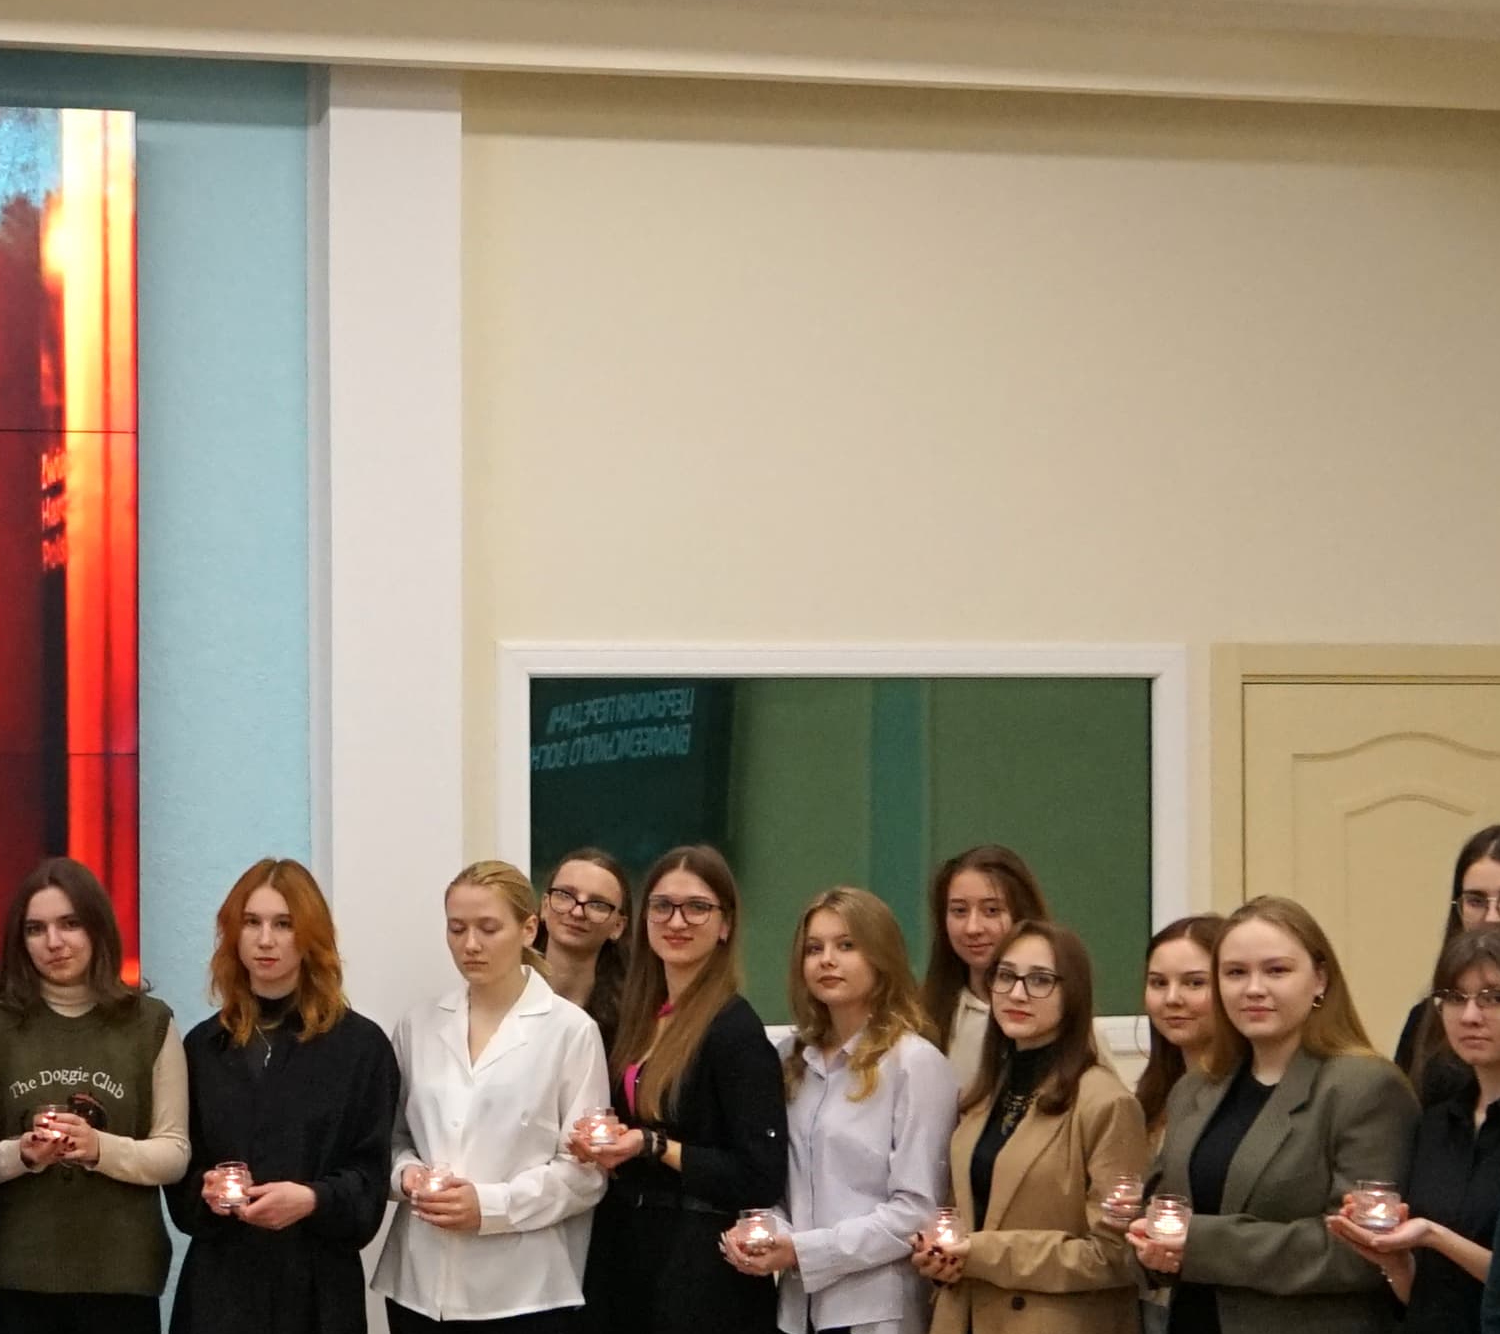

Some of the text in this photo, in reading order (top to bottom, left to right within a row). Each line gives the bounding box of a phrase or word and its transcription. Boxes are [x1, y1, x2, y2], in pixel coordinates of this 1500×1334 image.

[9, 1066, 125, 1100] The Doggie Club
